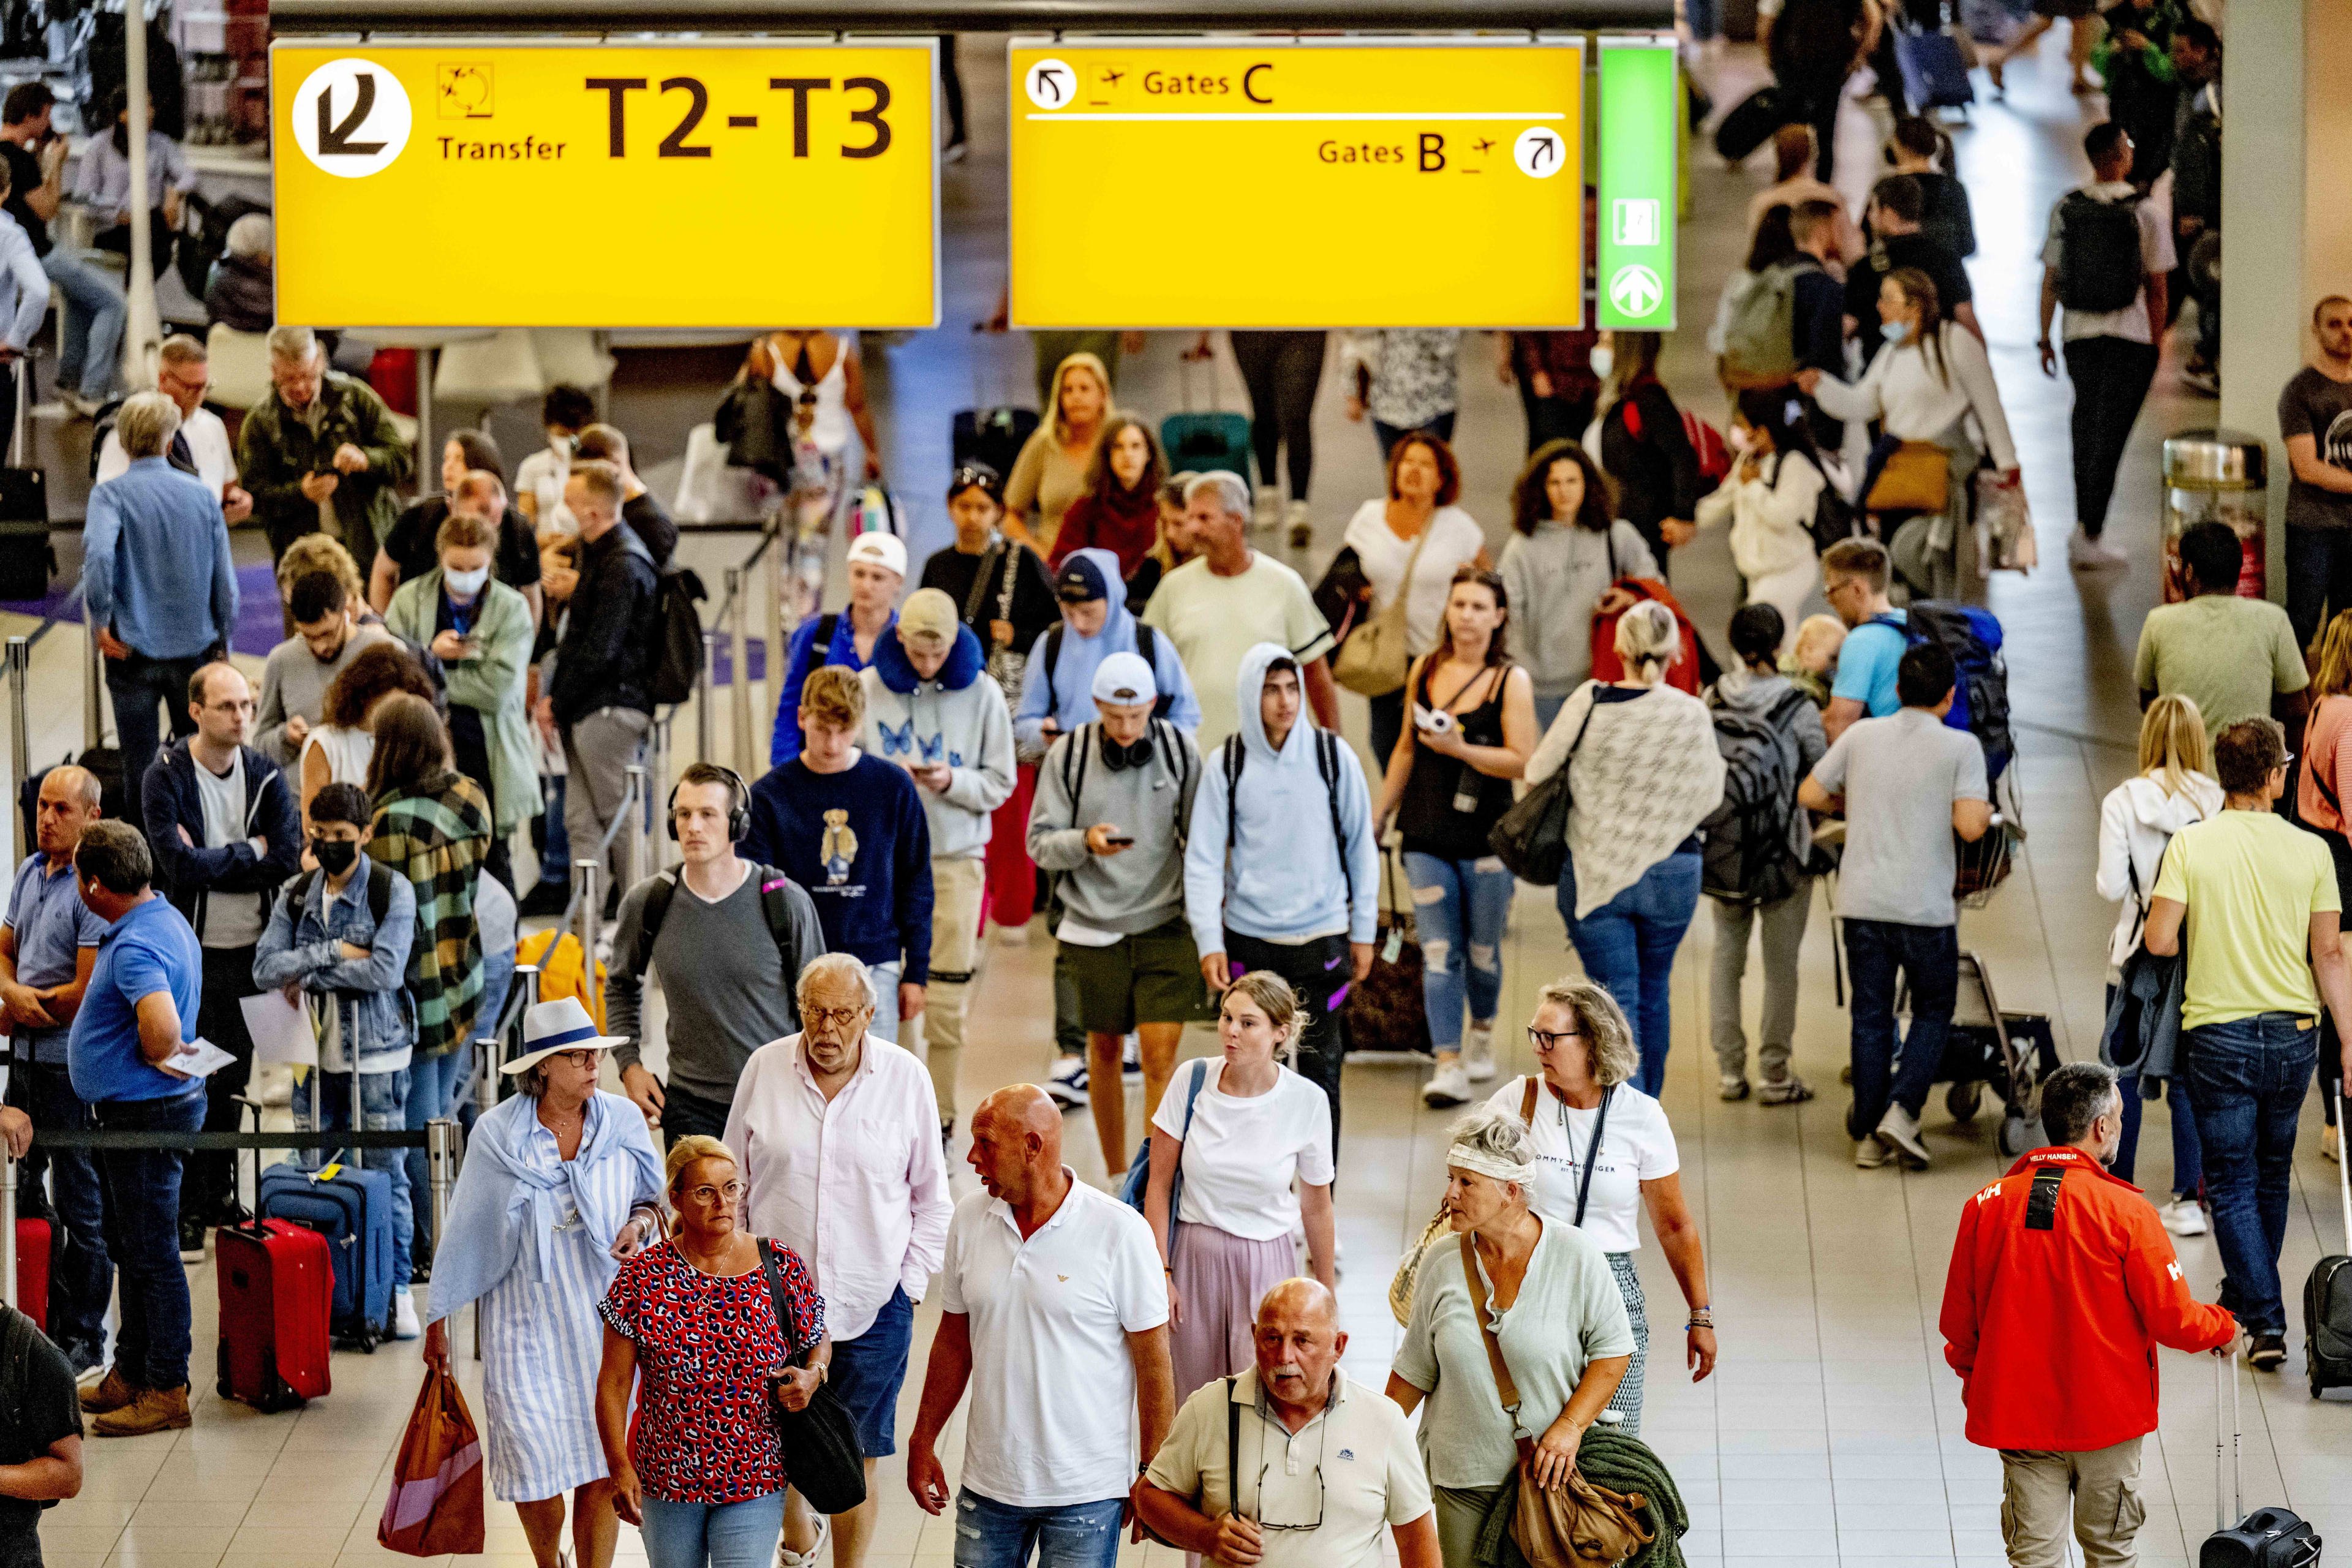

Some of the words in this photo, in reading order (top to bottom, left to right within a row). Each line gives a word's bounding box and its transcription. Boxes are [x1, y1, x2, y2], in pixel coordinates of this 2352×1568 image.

[1144, 71, 1229, 94] Gates
[1243, 63, 1273, 104] C
[585, 76, 892, 159] T2-T3
[438, 135, 567, 160] Transfer
[1319, 141, 1404, 163] Gates
[1419, 133, 1446, 173] B
[1536, 1154, 1563, 1163] OMMY
